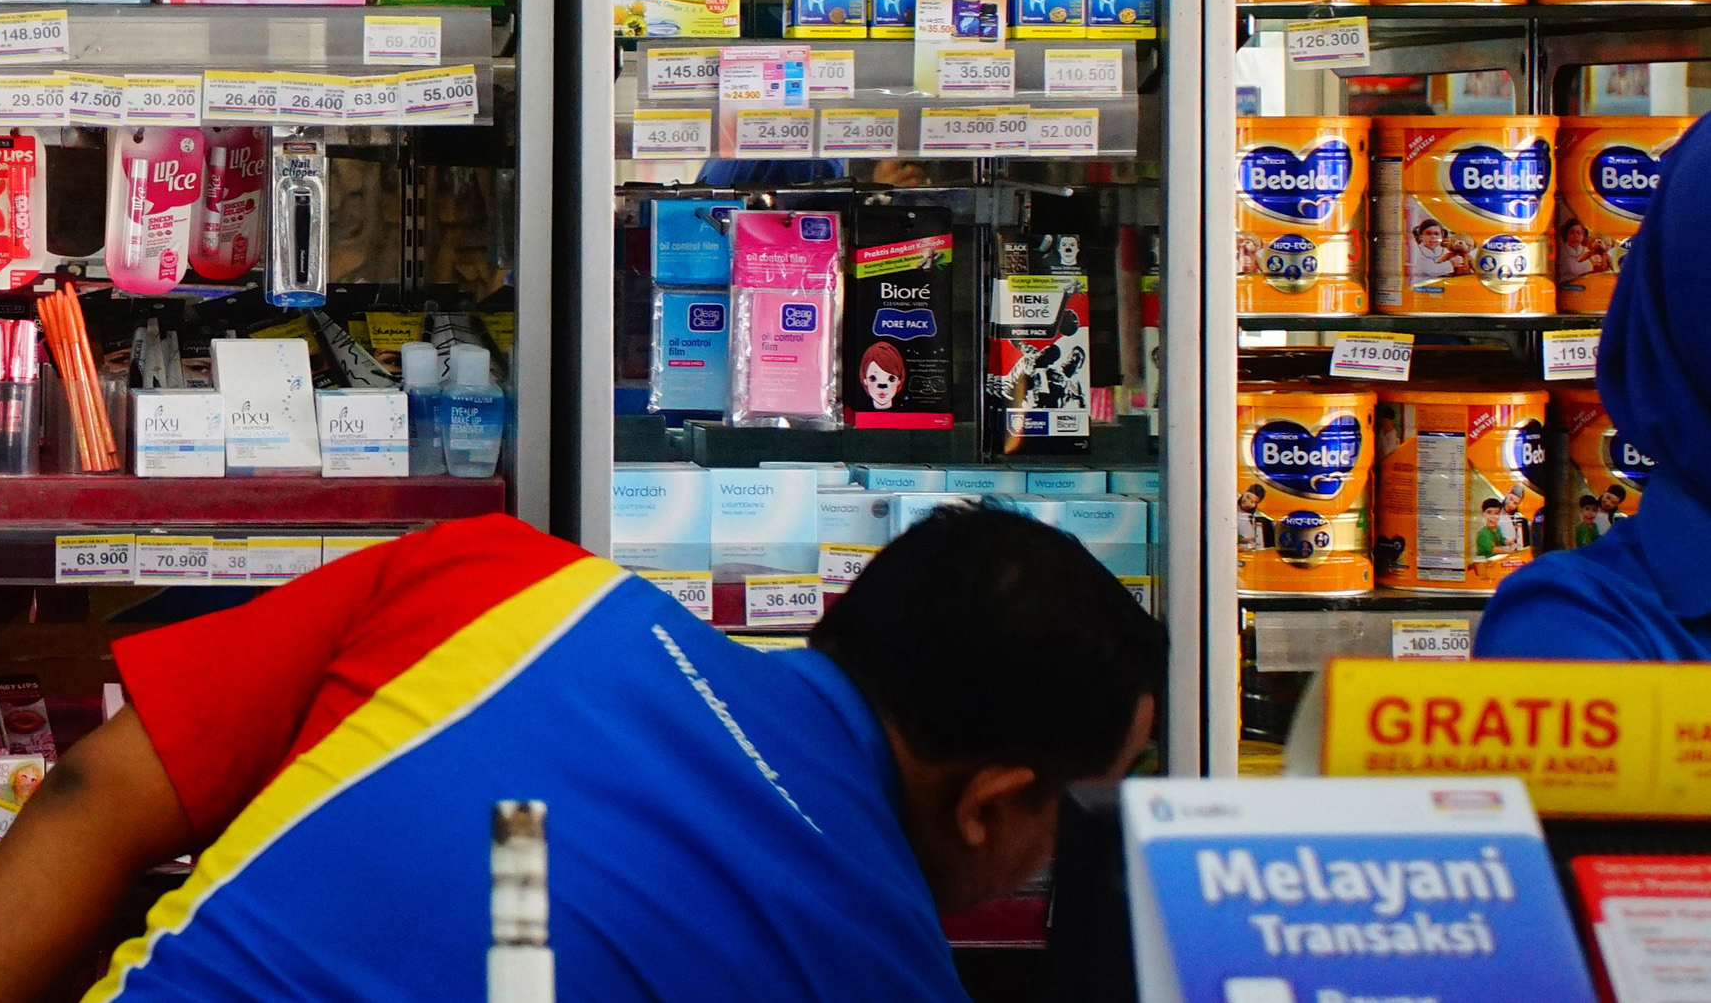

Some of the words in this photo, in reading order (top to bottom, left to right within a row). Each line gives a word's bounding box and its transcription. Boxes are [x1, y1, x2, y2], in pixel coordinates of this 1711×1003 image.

[0, 26, 61, 42] 148.900
[1296, 31, 1360, 50] 126.300
[385, 35, 437, 49] 69.200
[664, 64, 721, 79] 145.800
[960, 65, 1011, 79] 35.500
[1056, 68, 1116, 81] 110.500
[11, 93, 64, 107] 29.500
[69, 91, 122, 108] 47.500
[143, 93, 195, 107] 30.200
[225, 93, 276, 107] 26.400
[423, 84, 474, 103] 55.000
[757, 124, 809, 138] 24.900
[944, 119, 993, 134] 13.500
[1040, 125, 1092, 139] 52.000
[648, 129, 700, 143] 43.600
[3, 150, 34, 162] LIPS
[290, 159, 311, 168] Nail
[153, 159, 179, 184] LIP
[282, 168, 318, 178] Clipper
[1251, 166, 1340, 190] Bebelac
[1462, 166, 1545, 190] Bebelac
[881, 282, 931, 300] Bioré
[1012, 306, 1050, 319] Bioré
[882, 320, 903, 329] PORE
[905, 320, 928, 329] PACK
[668, 337, 679, 347] oil
[681, 338, 711, 348] control
[668, 348, 686, 357] film
[1349, 346, 1411, 362] 119.000
[144, 418, 180, 435] PIXY
[1262, 441, 1349, 466] Bebelac
[76, 551, 128, 566] 63.900
[156, 555, 207, 569] 70.900
[765, 592, 817, 607] 36.400
[1409, 636, 1469, 652] 108.500
[1366, 696, 1621, 749] GRATIS
[1365, 752, 1536, 774] BELANJAAN
[1545, 755, 1617, 775] ANDA
[1194, 844, 1516, 916] Melayani
[1248, 913, 1495, 957] Transaksi
